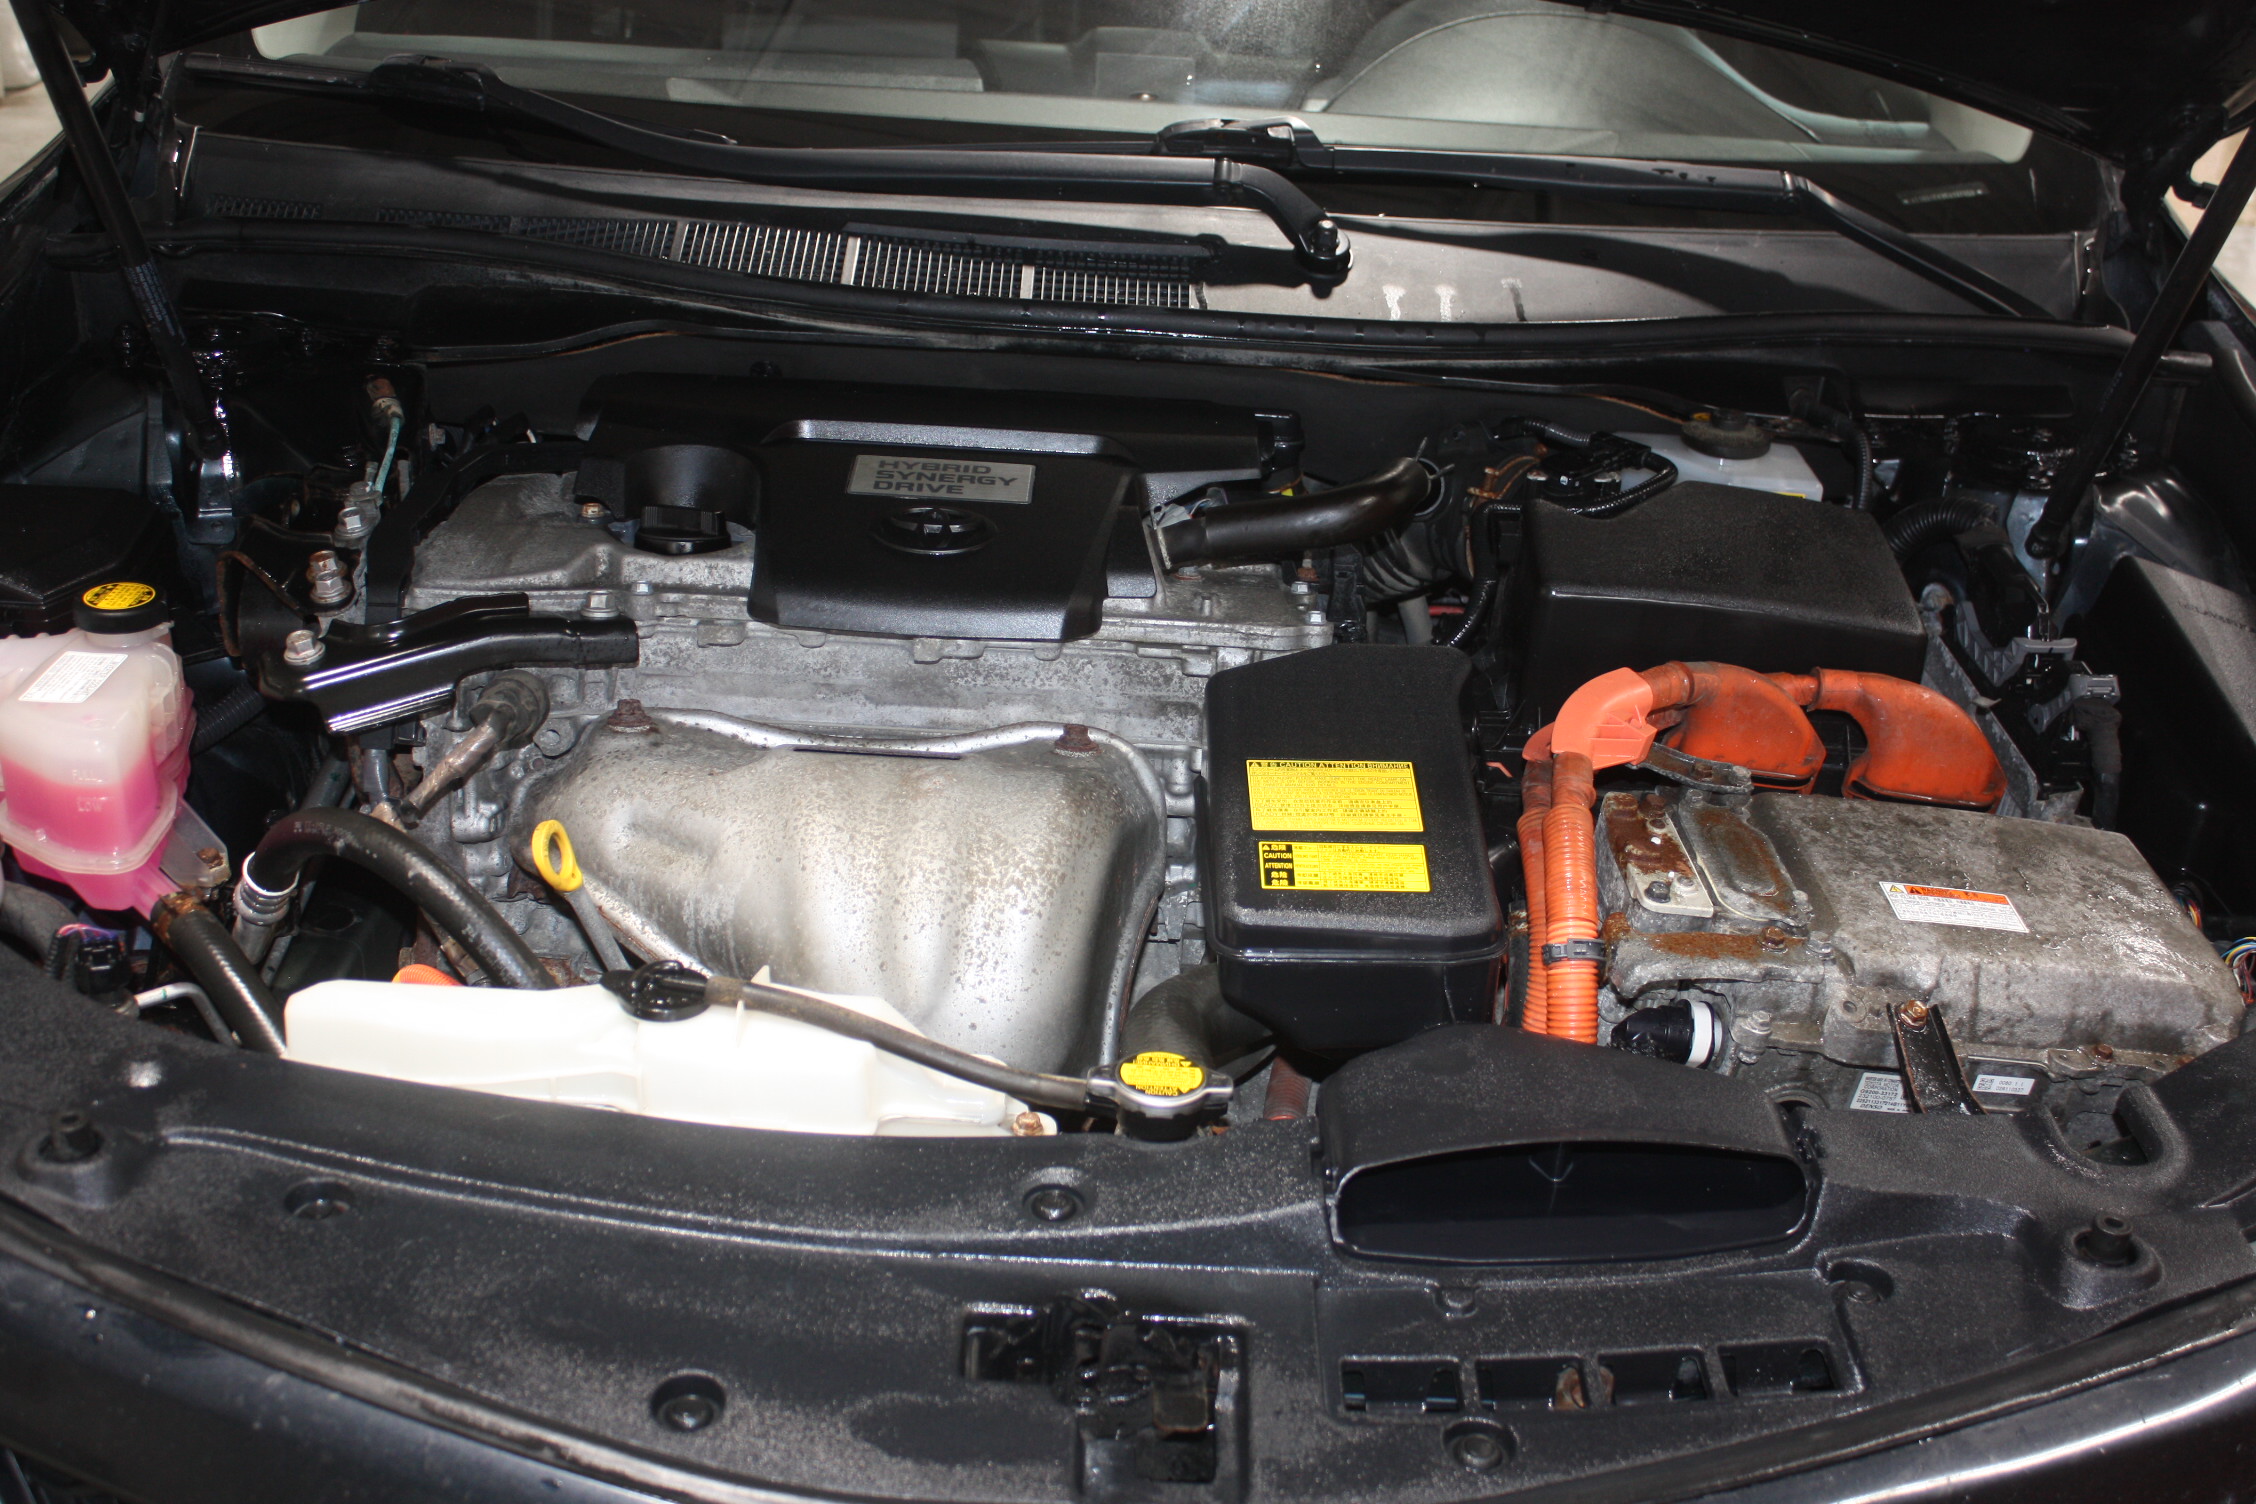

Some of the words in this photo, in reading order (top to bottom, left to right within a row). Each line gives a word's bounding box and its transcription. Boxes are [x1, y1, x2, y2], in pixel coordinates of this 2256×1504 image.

[878, 459, 992, 475] HYBRID
[875, 470, 1018, 487] SYNERGY
[872, 480, 964, 495] DRIVE
[1263, 852, 1293, 860] CAUTION
[1264, 862, 1293, 870] ATTENTION
[1144, 1089, 1178, 1097] CAUTION
